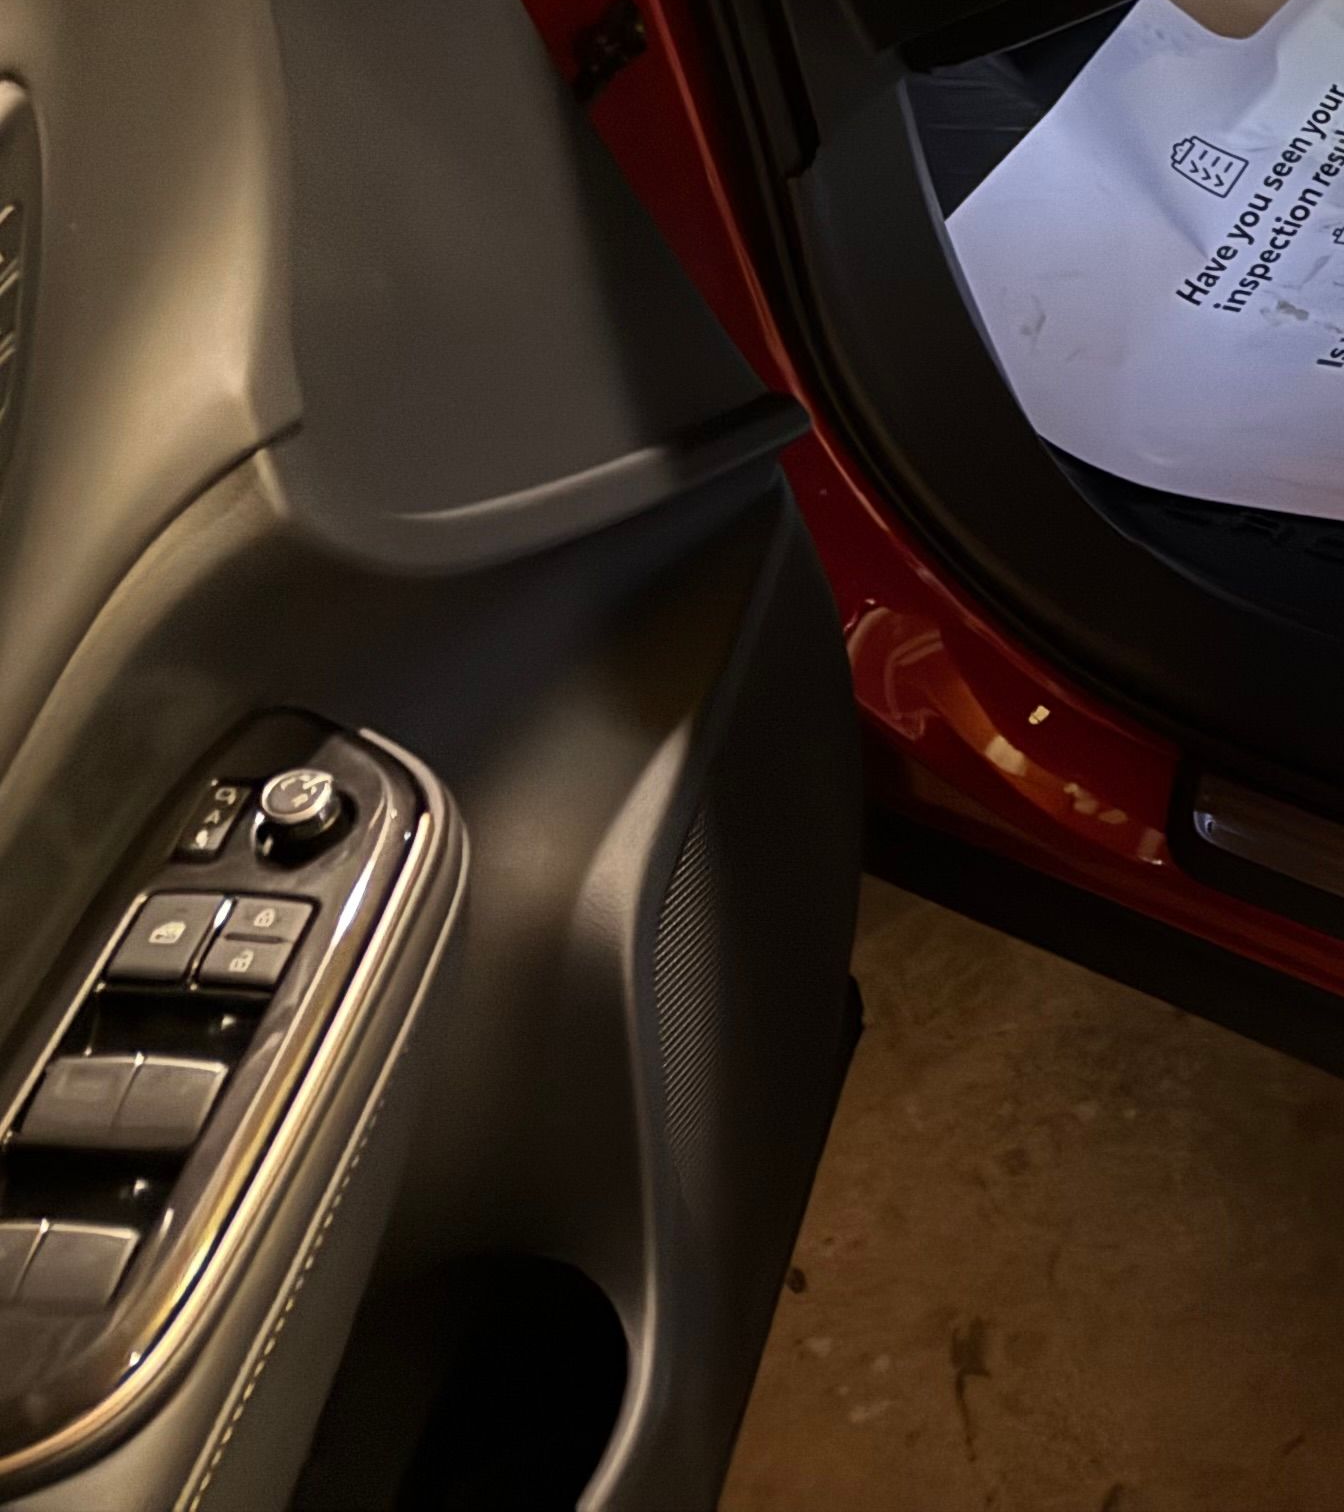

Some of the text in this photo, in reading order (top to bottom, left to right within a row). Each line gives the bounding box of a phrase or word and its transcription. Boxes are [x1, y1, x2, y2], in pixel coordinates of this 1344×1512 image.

[1176, 244, 1239, 306] Have
[1227, 192, 1273, 245] you
[1263, 137, 1313, 192] seen
[1213, 187, 1324, 313] inspection
